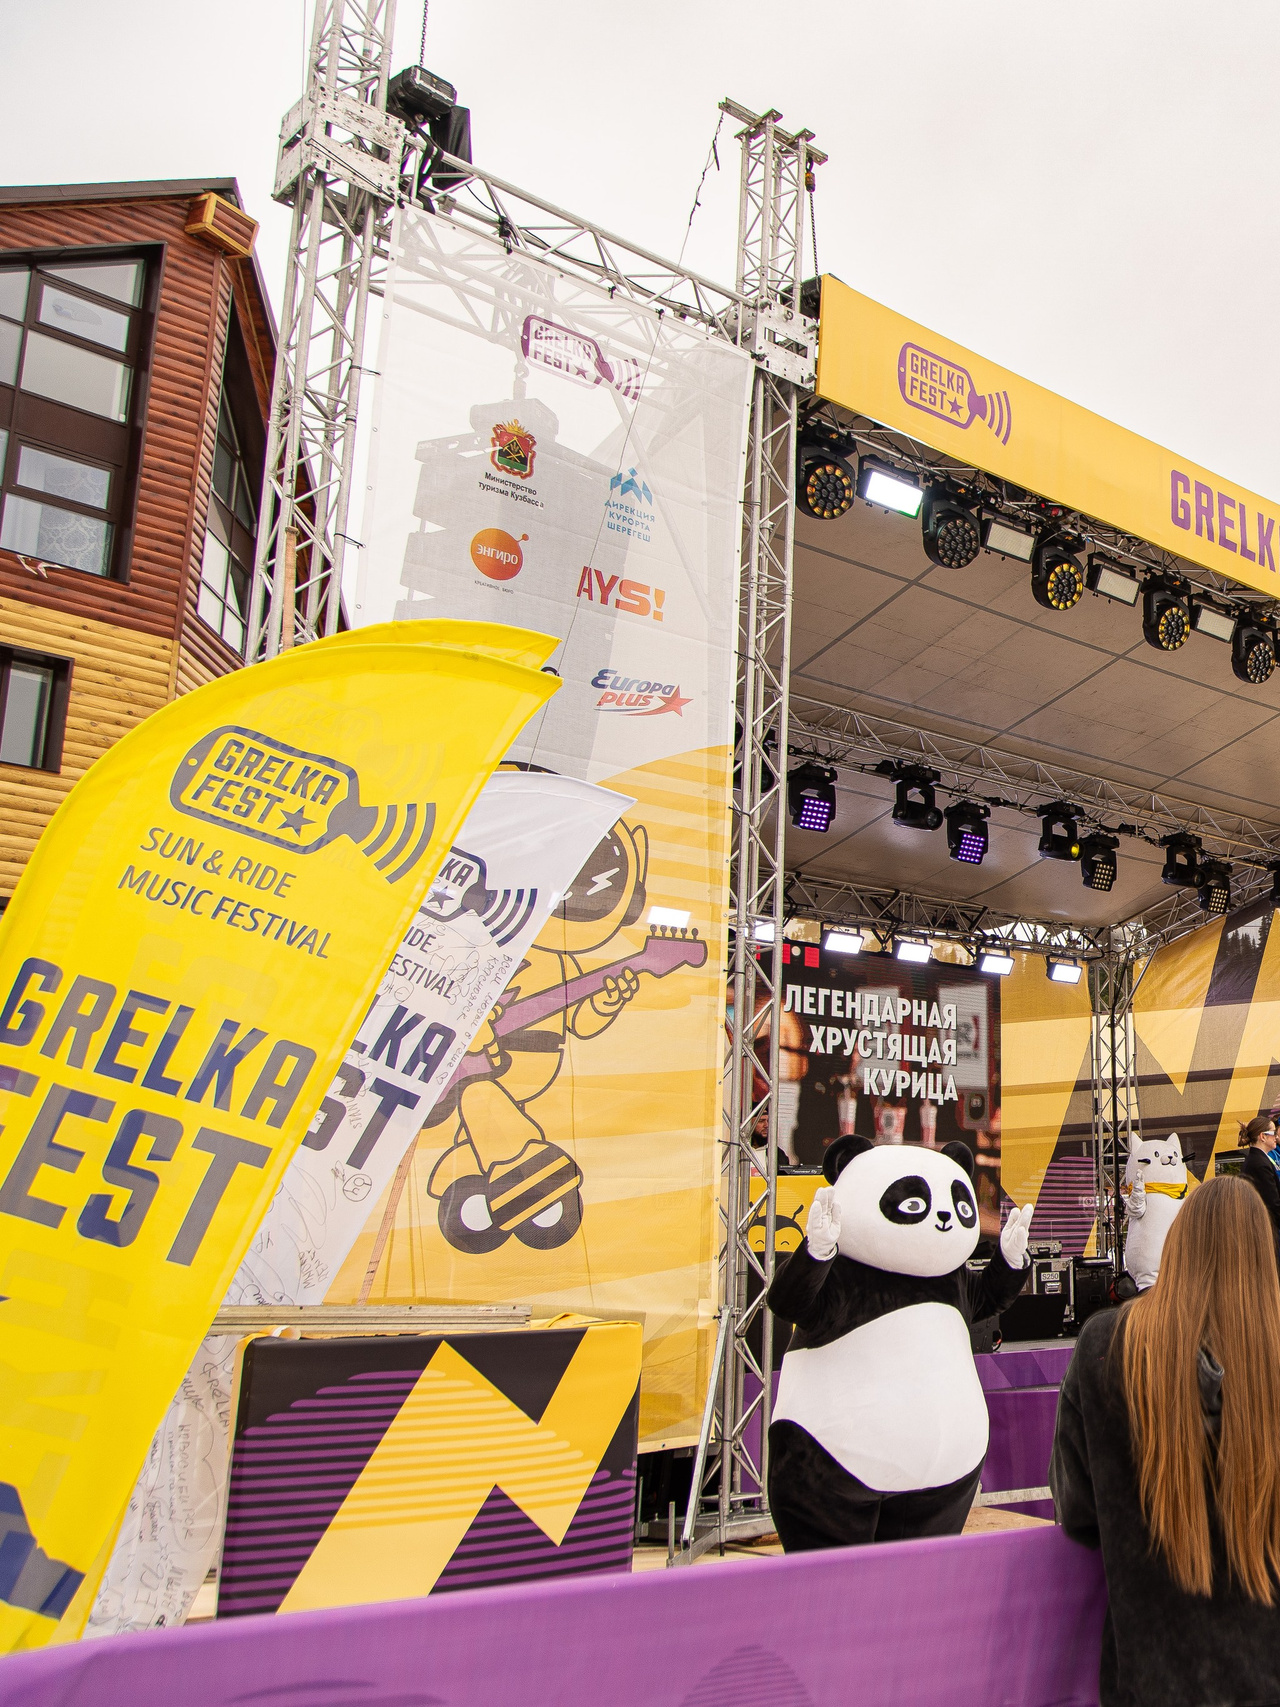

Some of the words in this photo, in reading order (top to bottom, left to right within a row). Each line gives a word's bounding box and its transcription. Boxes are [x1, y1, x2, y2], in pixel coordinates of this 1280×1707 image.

[533, 343, 573, 373] FEST
[910, 352, 965, 397] GRELKA
[910, 375, 947, 411] FEST
[478, 480, 509, 497] туризма
[510, 489, 545, 508] Кузбасса
[484, 472, 538, 496] Министерство
[604, 500, 656, 522] ДИРЕКЦИЯ
[608, 511, 652, 532] КУРОРТА
[607, 521, 651, 543] ШЕРЕГЕШ
[476, 544, 519, 566] энгиро
[577, 566, 666, 622] AYS!
[213, 738, 340, 806] GRELKA
[191, 779, 285, 824] FEST
[140, 826, 202, 870] SUN
[202, 849, 224, 876] &
[229, 856, 297, 899] RIDE
[118, 864, 213, 919] MUSIC
[210, 898, 332, 960] FESTIVAL
[402, 926, 437, 954] IDE
[389, 953, 455, 1000] ESTIVAL
[784, 984, 958, 1030] ЛЕГЕНДАРНАЯ
[0, 956, 318, 1130] GRELKA
[808, 1025, 958, 1067] ХРУСТЯЩАЯ
[863, 1068, 959, 1106] КУРИЦА
[0, 1064, 273, 1267] EST
[1042, 1272, 1059, 1281] S250
